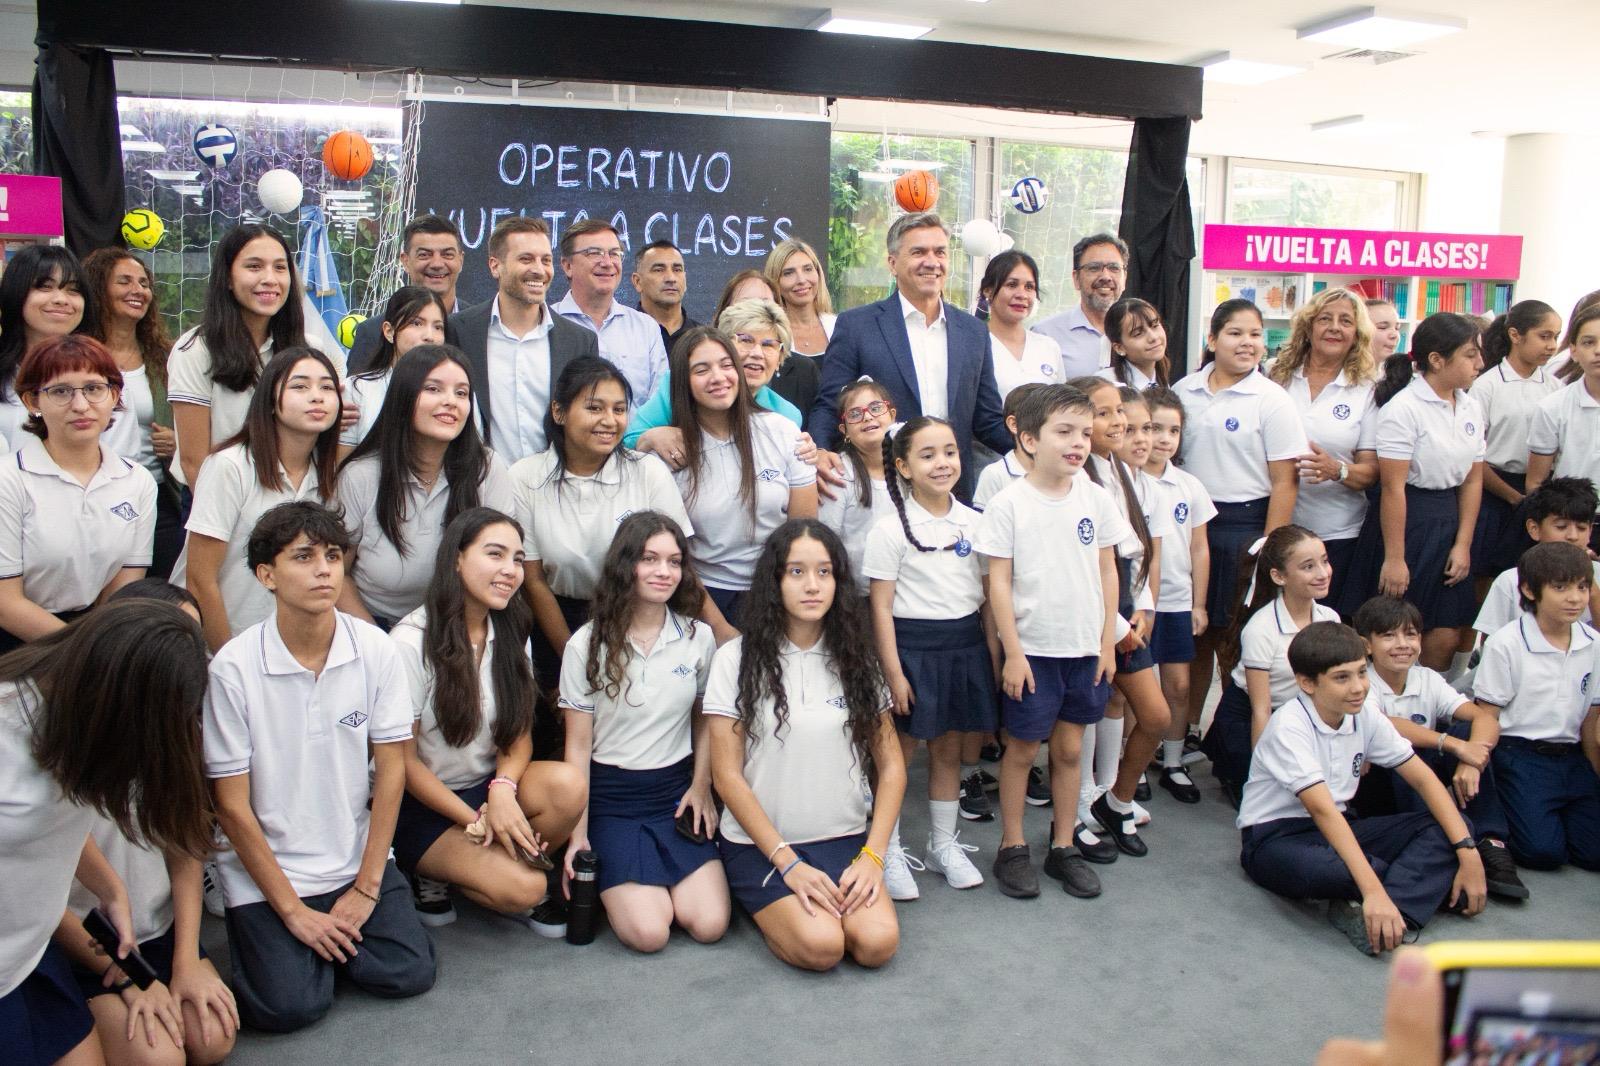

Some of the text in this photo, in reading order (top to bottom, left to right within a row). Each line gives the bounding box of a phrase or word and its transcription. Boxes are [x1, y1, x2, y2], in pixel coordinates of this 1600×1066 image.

[498, 142, 731, 193] OPERATIVO
[611, 209, 630, 251] A
[644, 211, 792, 256] CLASES
[1245, 234, 1489, 270] ¡VUELTA A CLASES!
